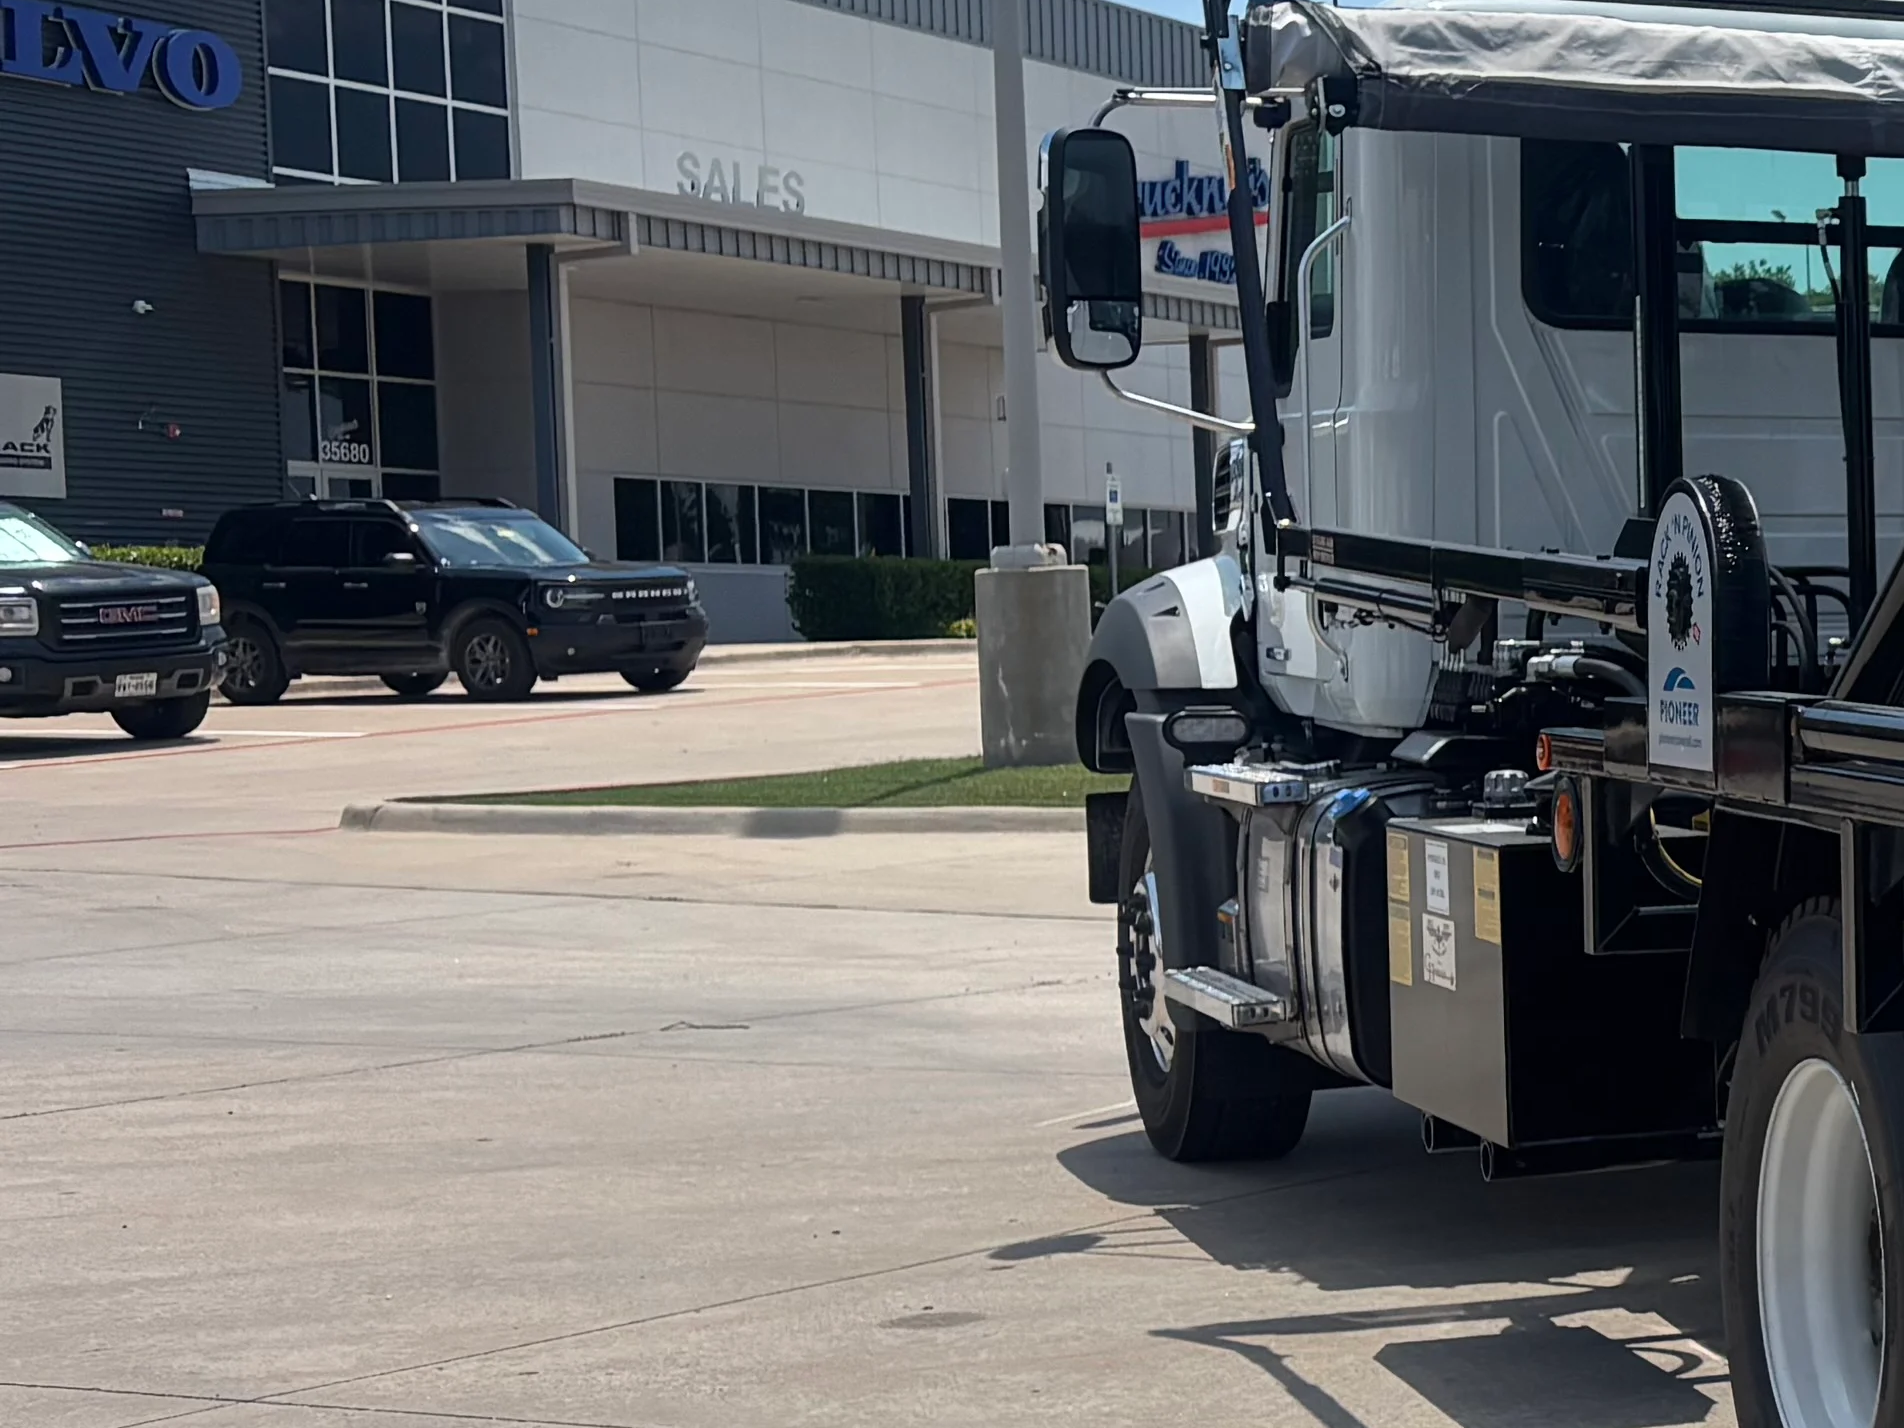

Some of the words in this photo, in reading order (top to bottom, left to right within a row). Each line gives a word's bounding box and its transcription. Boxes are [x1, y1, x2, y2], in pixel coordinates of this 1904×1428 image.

[676, 150, 805, 215] SALES
[0, 441, 51, 454] ACK
[321, 440, 369, 463] 35680
[1655, 523, 1672, 598] RACK
[1681, 515, 1705, 598] PINION
[99, 606, 158, 624] GMC
[1659, 698, 1700, 727] PIONEER
